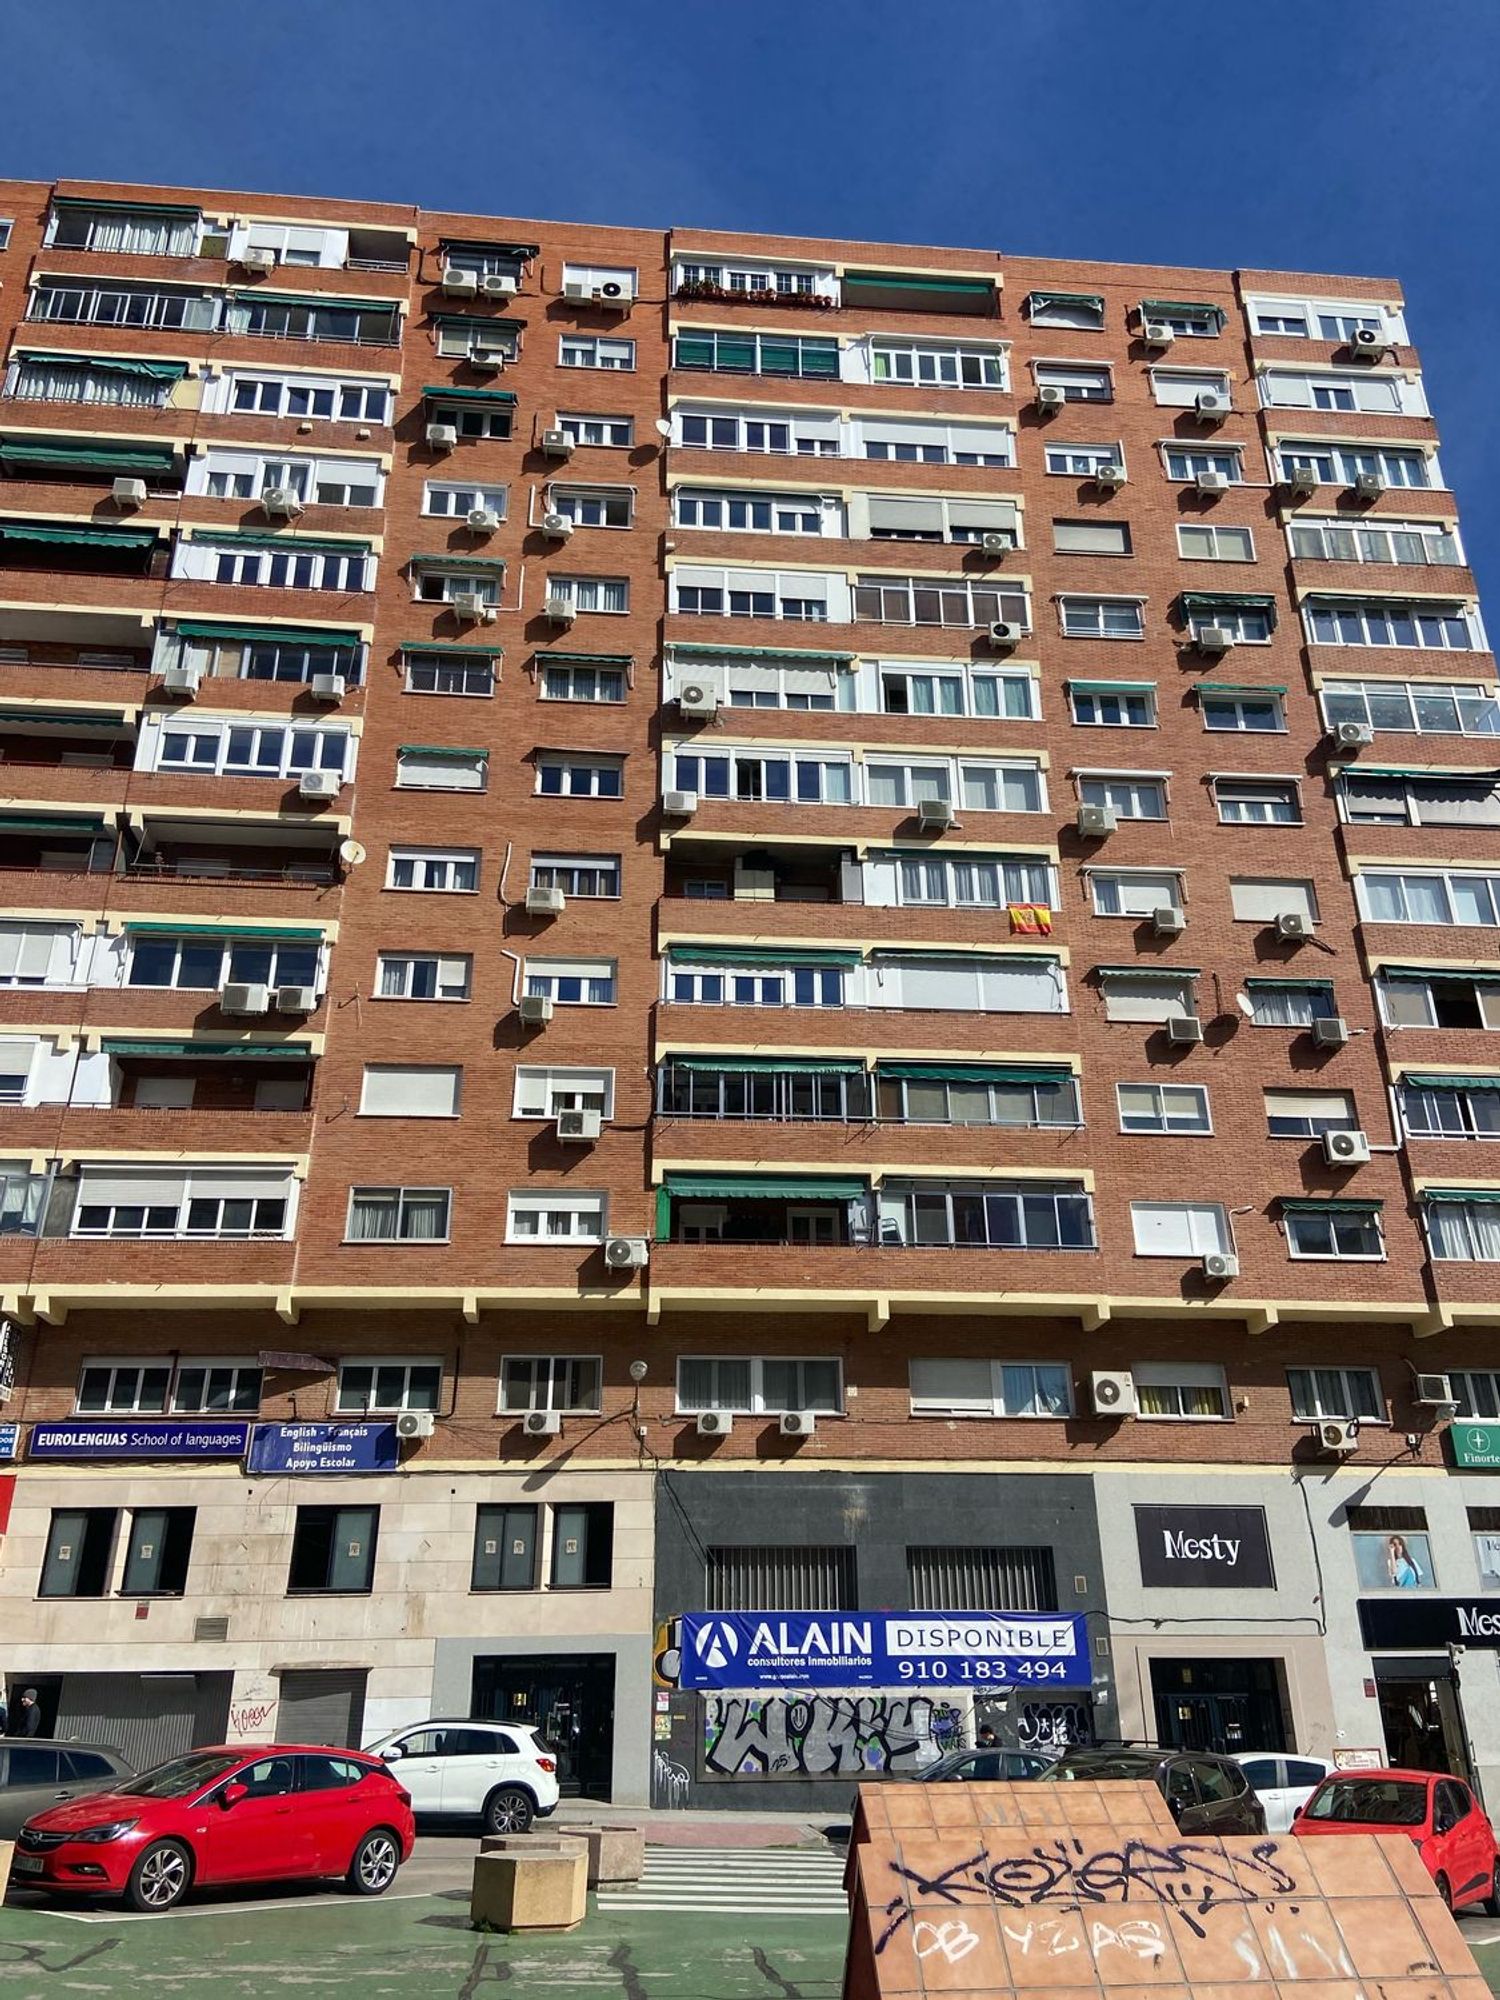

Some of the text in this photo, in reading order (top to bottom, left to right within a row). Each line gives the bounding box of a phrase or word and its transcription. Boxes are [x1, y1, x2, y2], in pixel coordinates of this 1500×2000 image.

[37, 1432, 242, 1449] EUROLENGUAS School of languages
[280, 1426, 317, 1440] English
[292, 1441, 352, 1455] Bilingüismo
[285, 1456, 356, 1471] Apoyo Escolar
[1162, 1529, 1242, 1566] Mesty
[748, 1621, 1068, 1655] ALAIN DISPONIBLE
[747, 1656, 806, 1667] consultores
[898, 1660, 1067, 1680] 910 183 494
